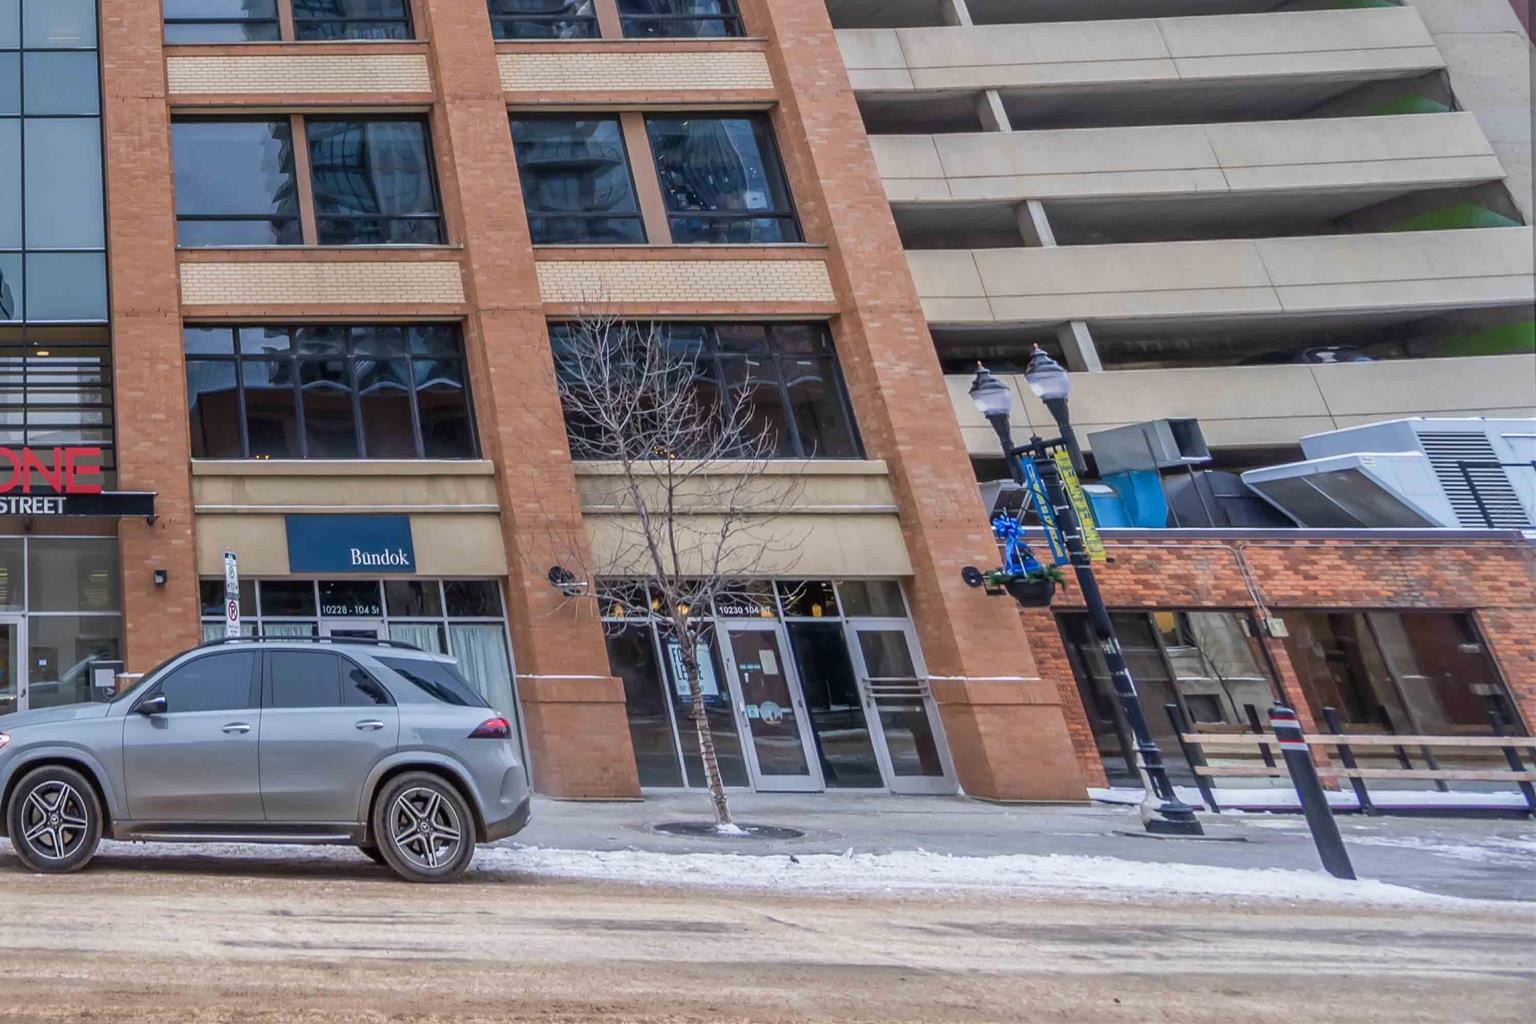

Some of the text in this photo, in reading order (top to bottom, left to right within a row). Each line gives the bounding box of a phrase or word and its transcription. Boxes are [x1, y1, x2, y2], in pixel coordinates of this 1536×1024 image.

[350, 548, 410, 566] Bundok
[322, 604, 348, 615] 10228
[354, 604, 369, 615] 104
[719, 605, 743, 615] 10230
[745, 605, 759, 615] 104
[675, 664, 703, 681] LEE
